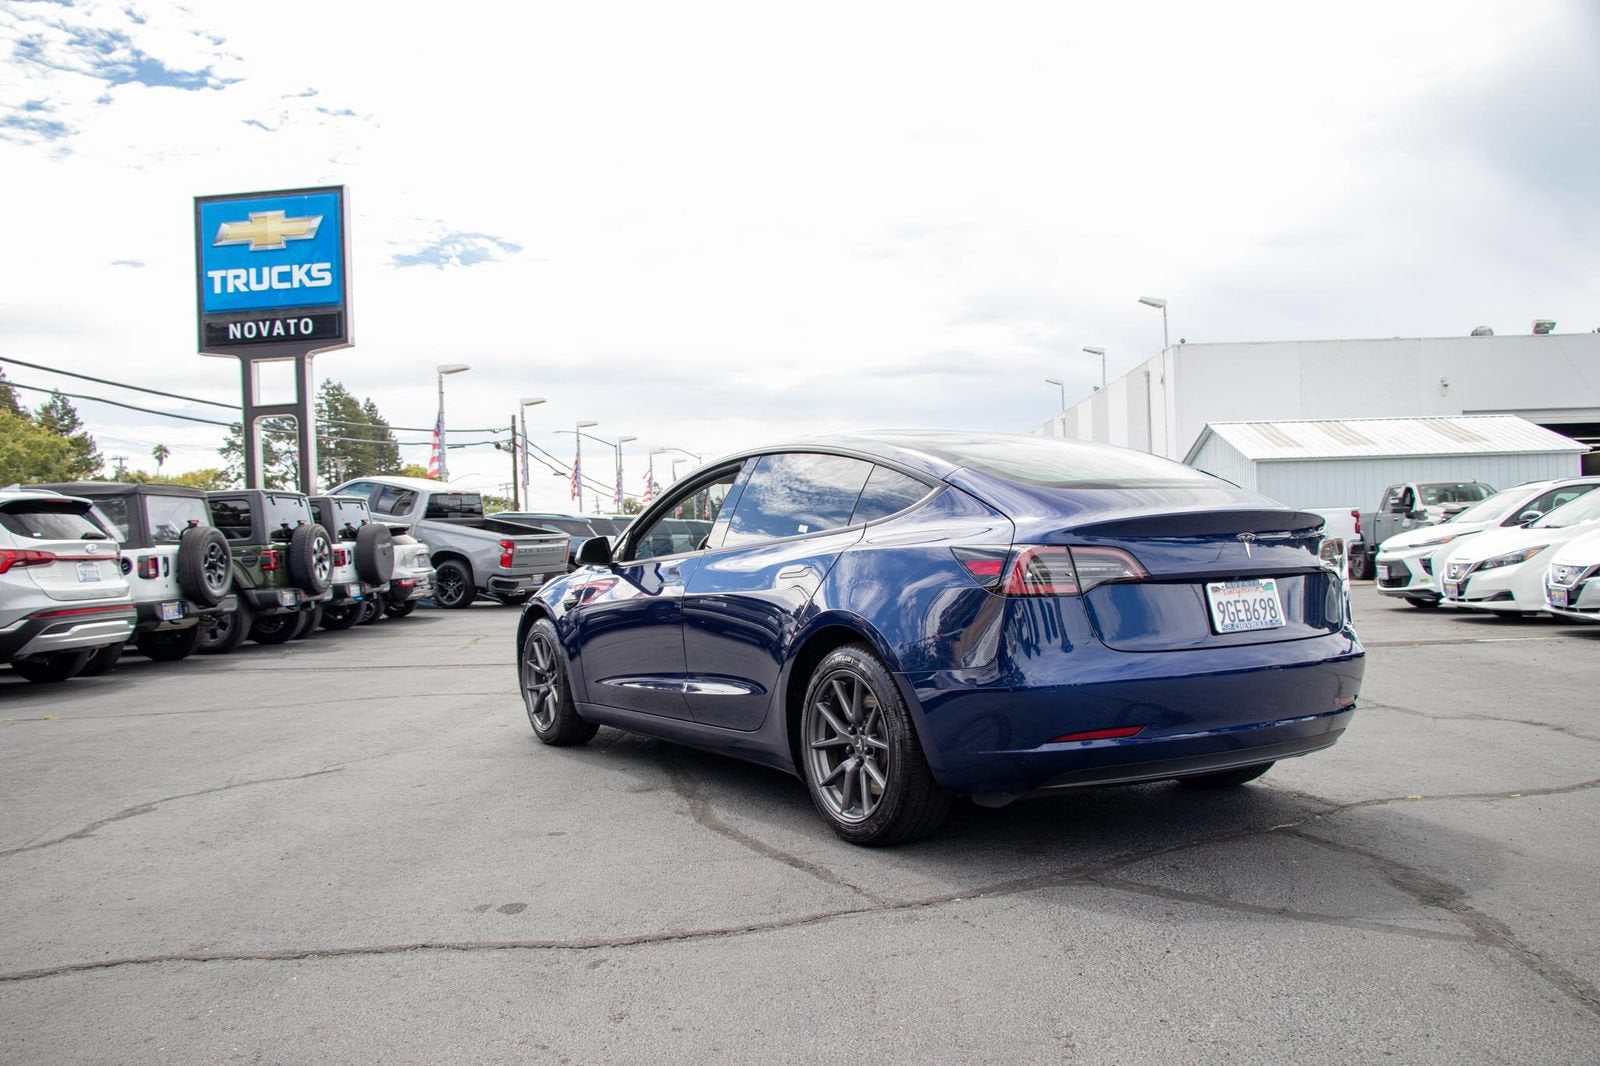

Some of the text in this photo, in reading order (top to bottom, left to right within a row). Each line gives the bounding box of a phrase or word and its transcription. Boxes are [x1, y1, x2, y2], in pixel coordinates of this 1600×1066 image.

[207, 262, 332, 294] TRUCKS
[228, 317, 313, 340] NOVATO
[1217, 597, 1277, 624] 9GEB698
